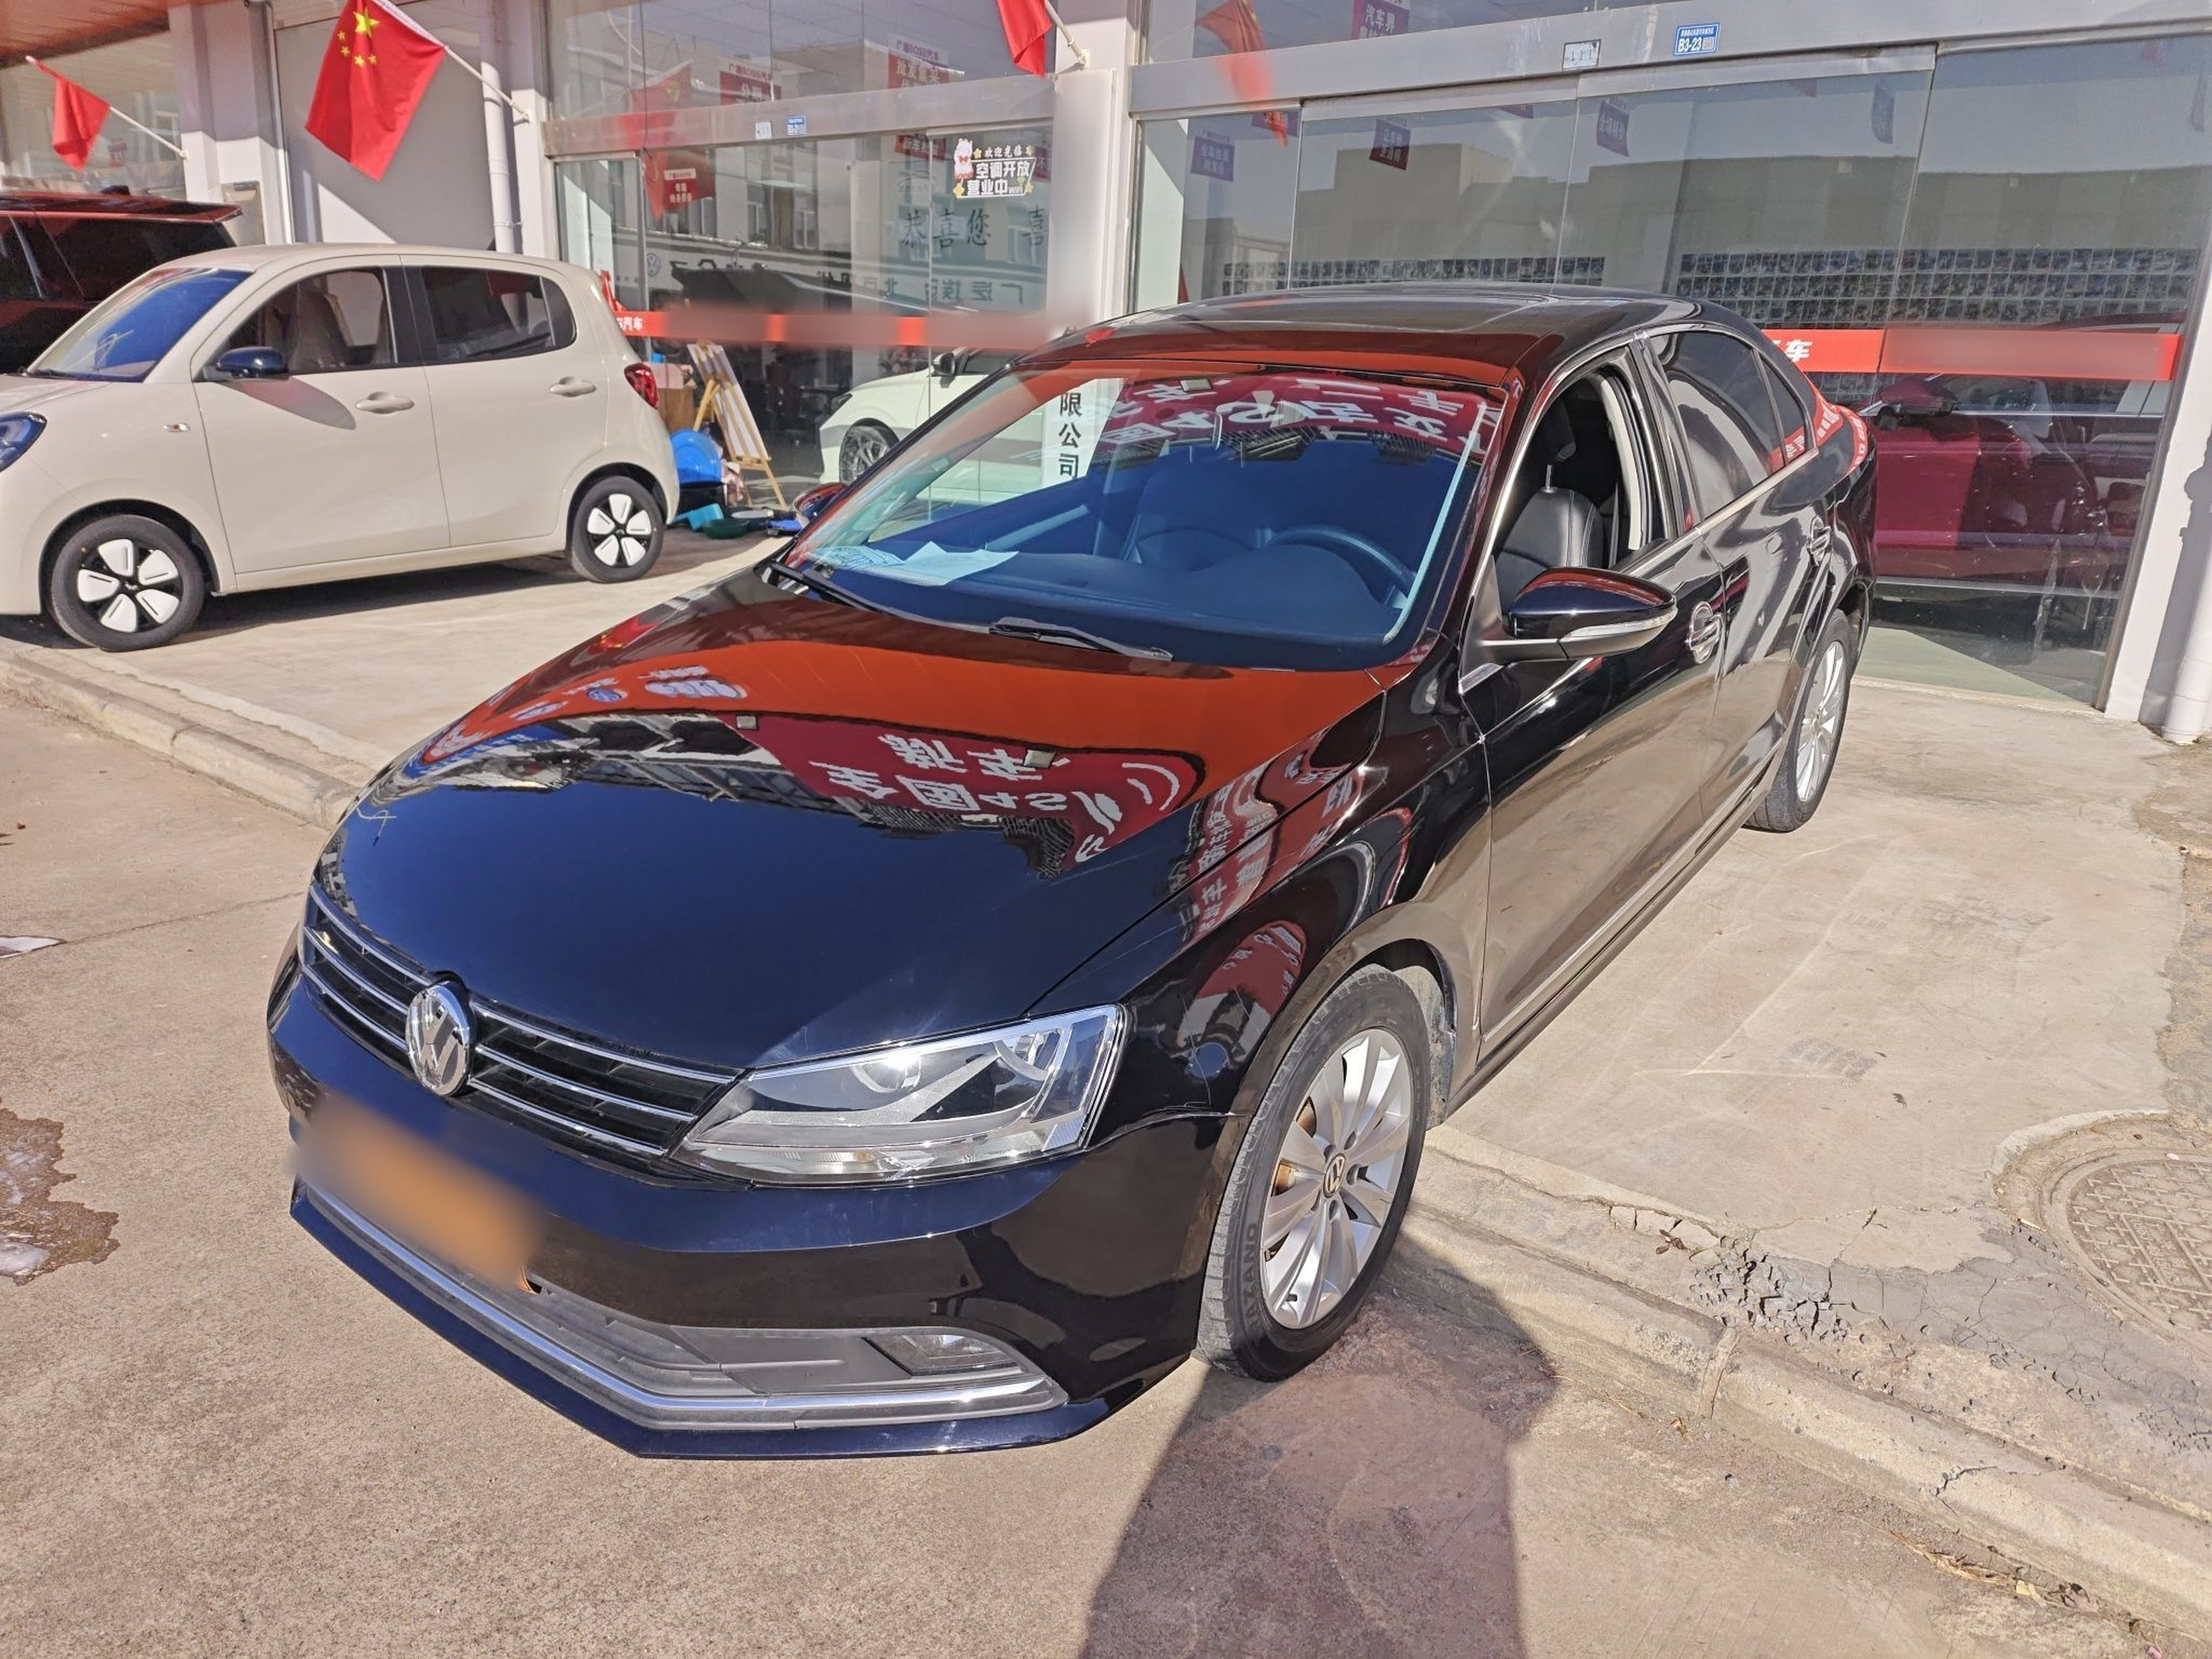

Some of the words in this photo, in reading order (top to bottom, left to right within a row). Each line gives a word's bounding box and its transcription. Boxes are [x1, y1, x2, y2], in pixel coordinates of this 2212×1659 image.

[1677, 37, 1702, 52] B3-23
[976, 161, 1030, 179] 空调开放
[967, 179, 1008, 196] 营业中
[900, 207, 991, 249] 恭喜您
[1058, 392, 1082, 479] 限公司
